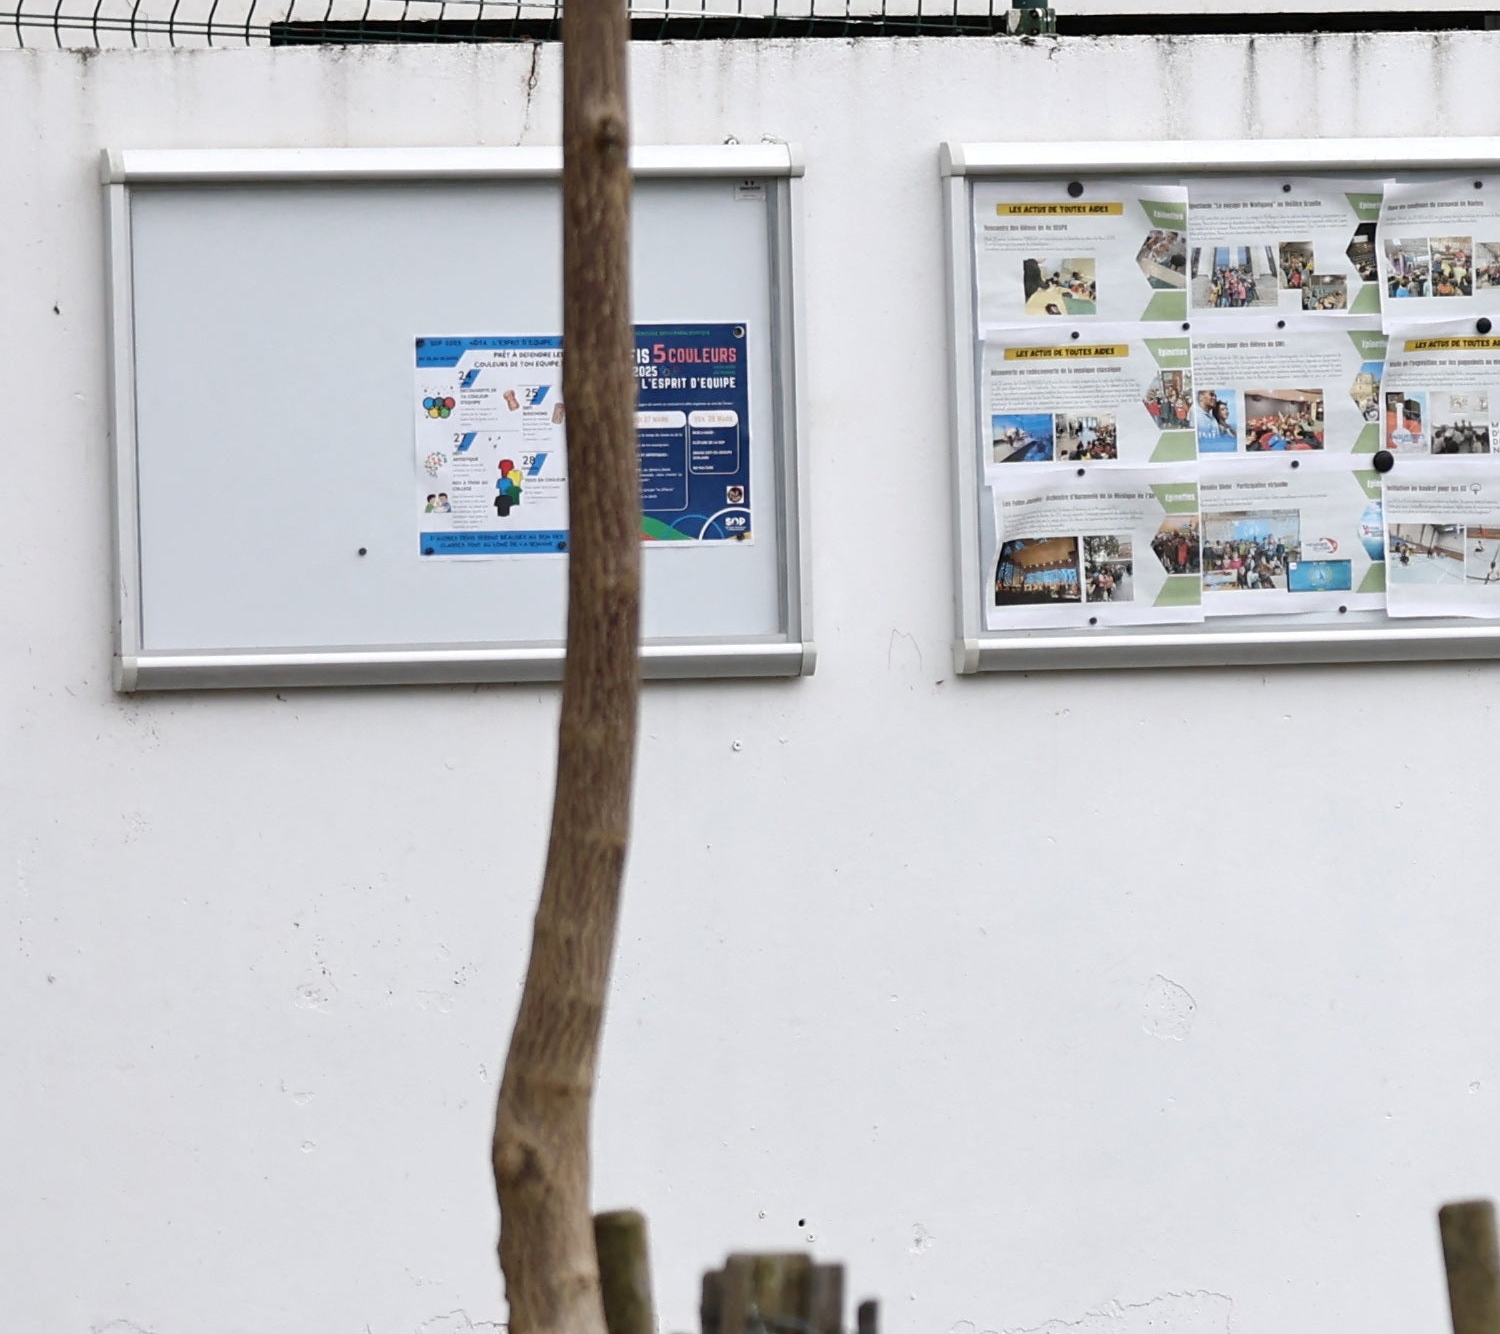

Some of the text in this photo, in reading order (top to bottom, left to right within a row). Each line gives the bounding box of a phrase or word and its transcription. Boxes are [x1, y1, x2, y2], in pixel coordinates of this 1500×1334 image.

[1415, 341, 1427, 349] LES
[1451, 340, 1461, 348] DE
[1463, 339, 1490, 347] TOUTES
[653, 343, 737, 364] 5 COULEURS
[1016, 349, 1028, 357] LES
[1053, 349, 1063, 357] DE
[1065, 348, 1090, 356] TOUTES
[632, 365, 658, 377] 2025
[641, 376, 737, 390] L'ESPRIT D'EQUIPE
[525, 388, 539, 398] 25
